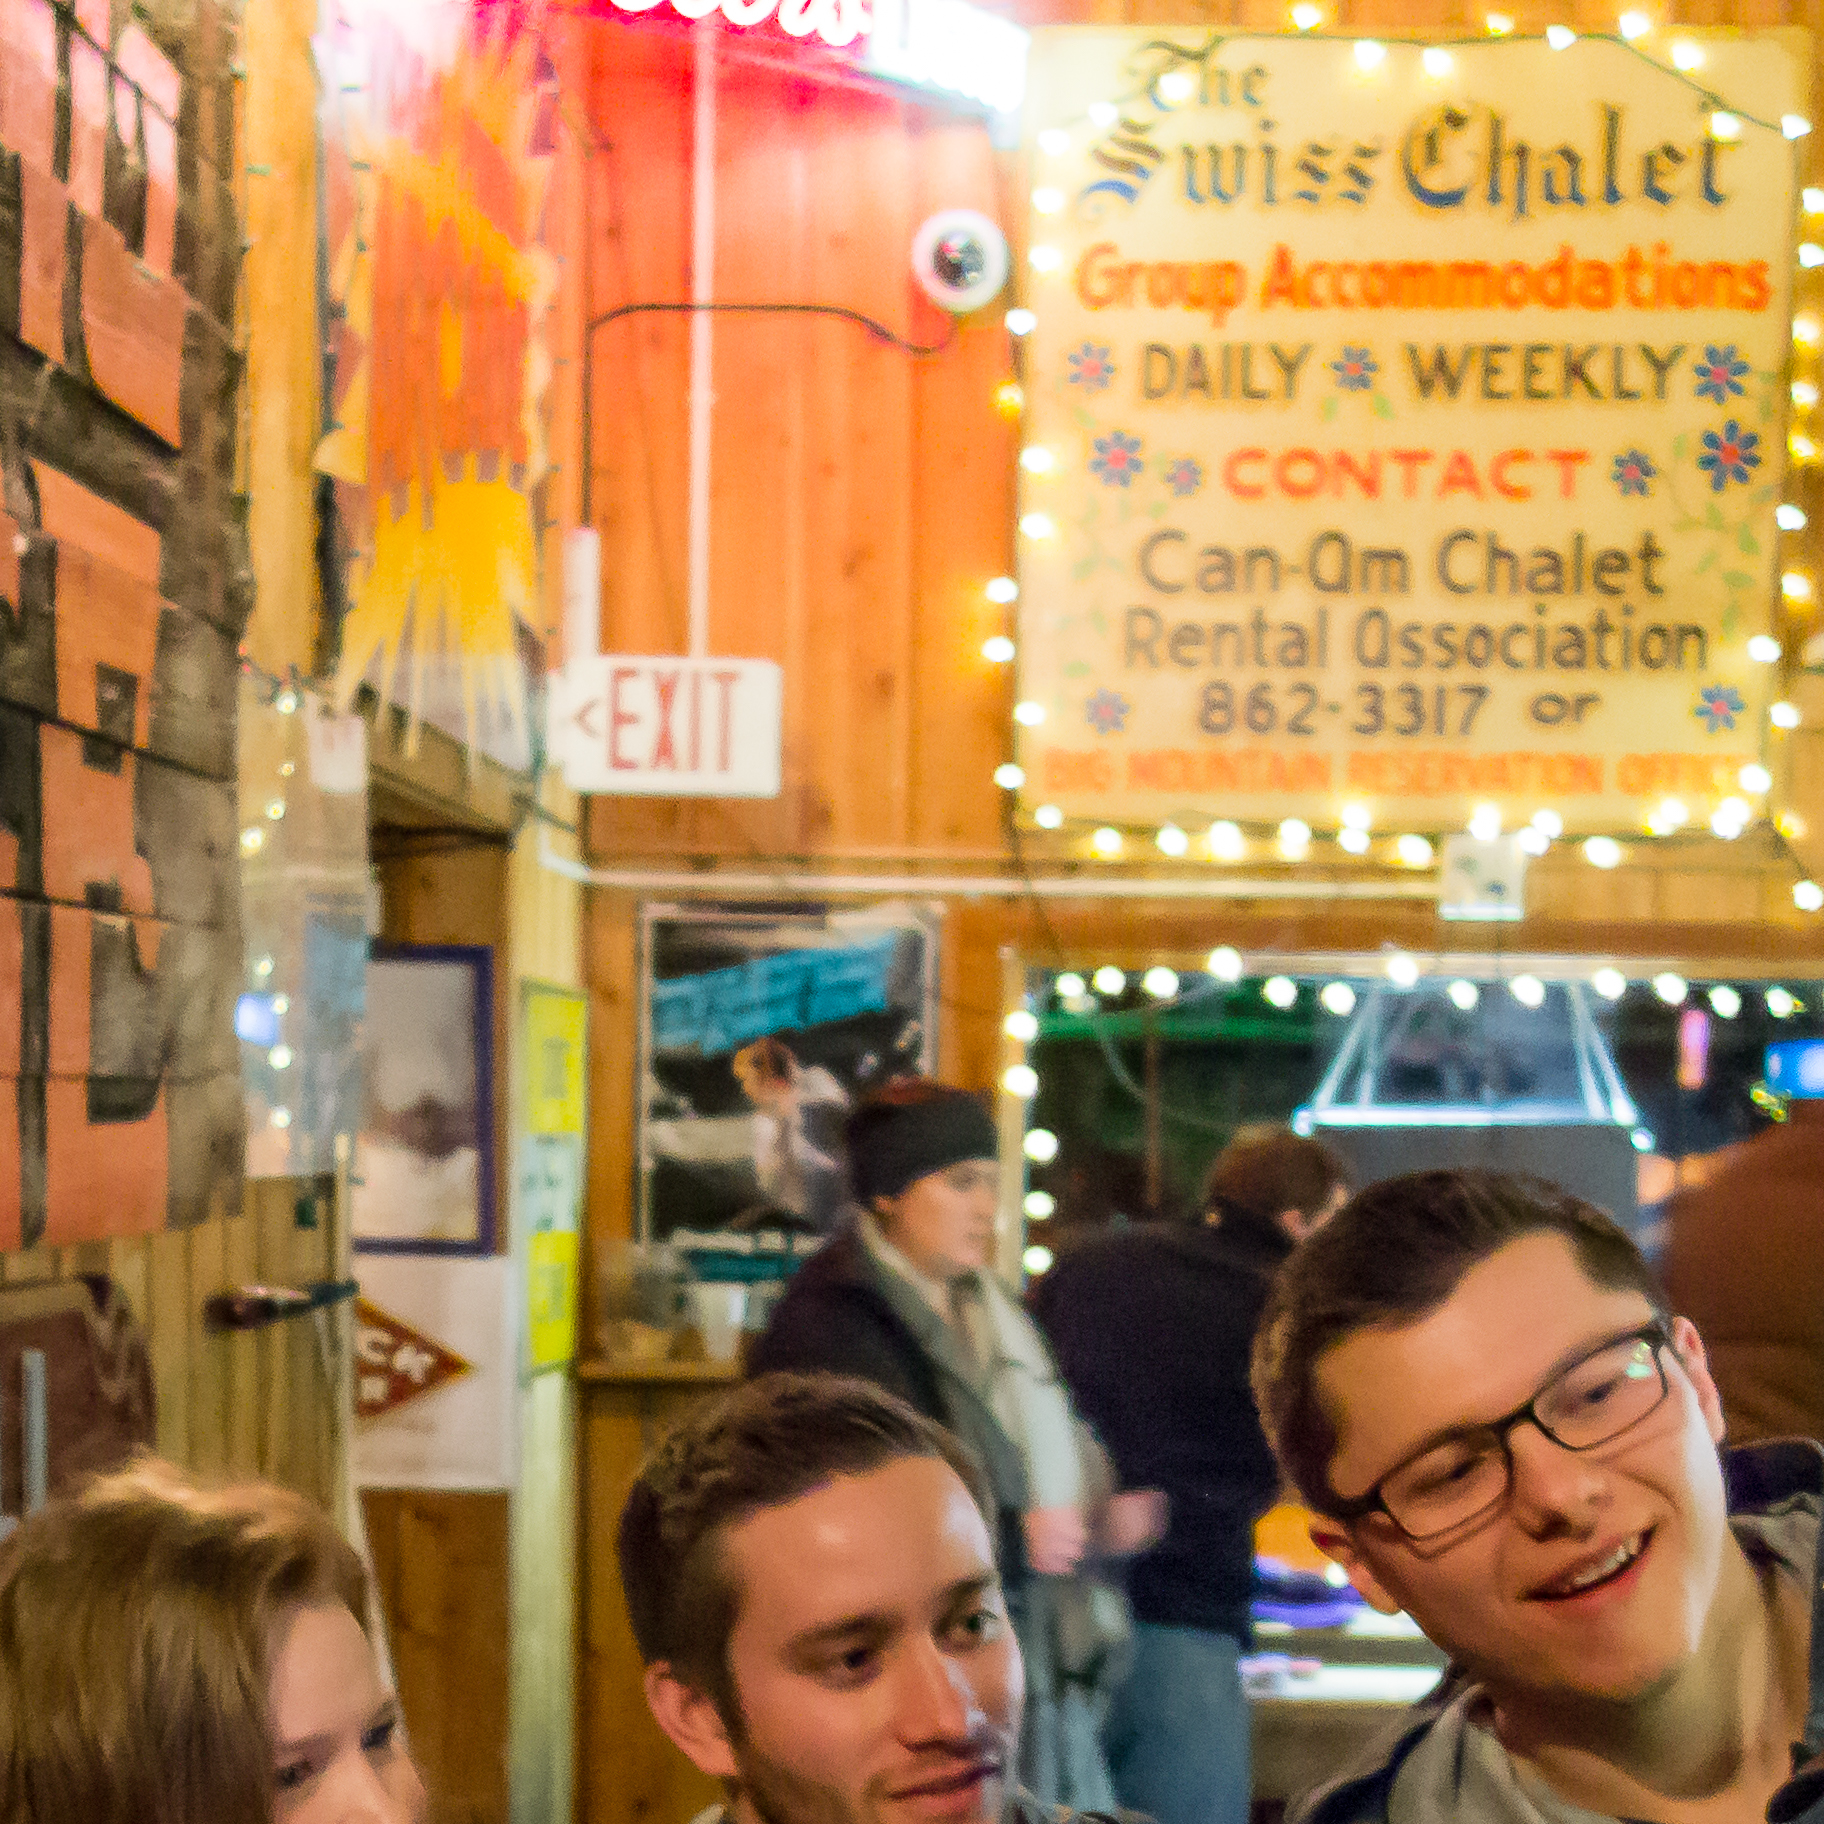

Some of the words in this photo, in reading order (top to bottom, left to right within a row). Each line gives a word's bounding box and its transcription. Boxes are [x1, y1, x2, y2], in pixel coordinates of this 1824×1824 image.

[1124, 40, 1270, 111] The
[1078, 117, 1383, 223] Swiss
[1401, 100, 1743, 221] Chalet
[1074, 244, 1248, 327] Group
[1261, 244, 1774, 314] Accommodations
[1140, 343, 1313, 402] DAILY
[1404, 343, 1690, 402] WEEKLY
[1223, 448, 1591, 500] CONTACT
[1437, 530, 1665, 599] Chalet
[1125, 607, 1329, 671] Rental
[1355, 602, 1708, 671] Association
[606, 668, 742, 773] EXIT
[1197, 683, 1489, 737] 862-3317
[1533, 688, 1601, 727] or
